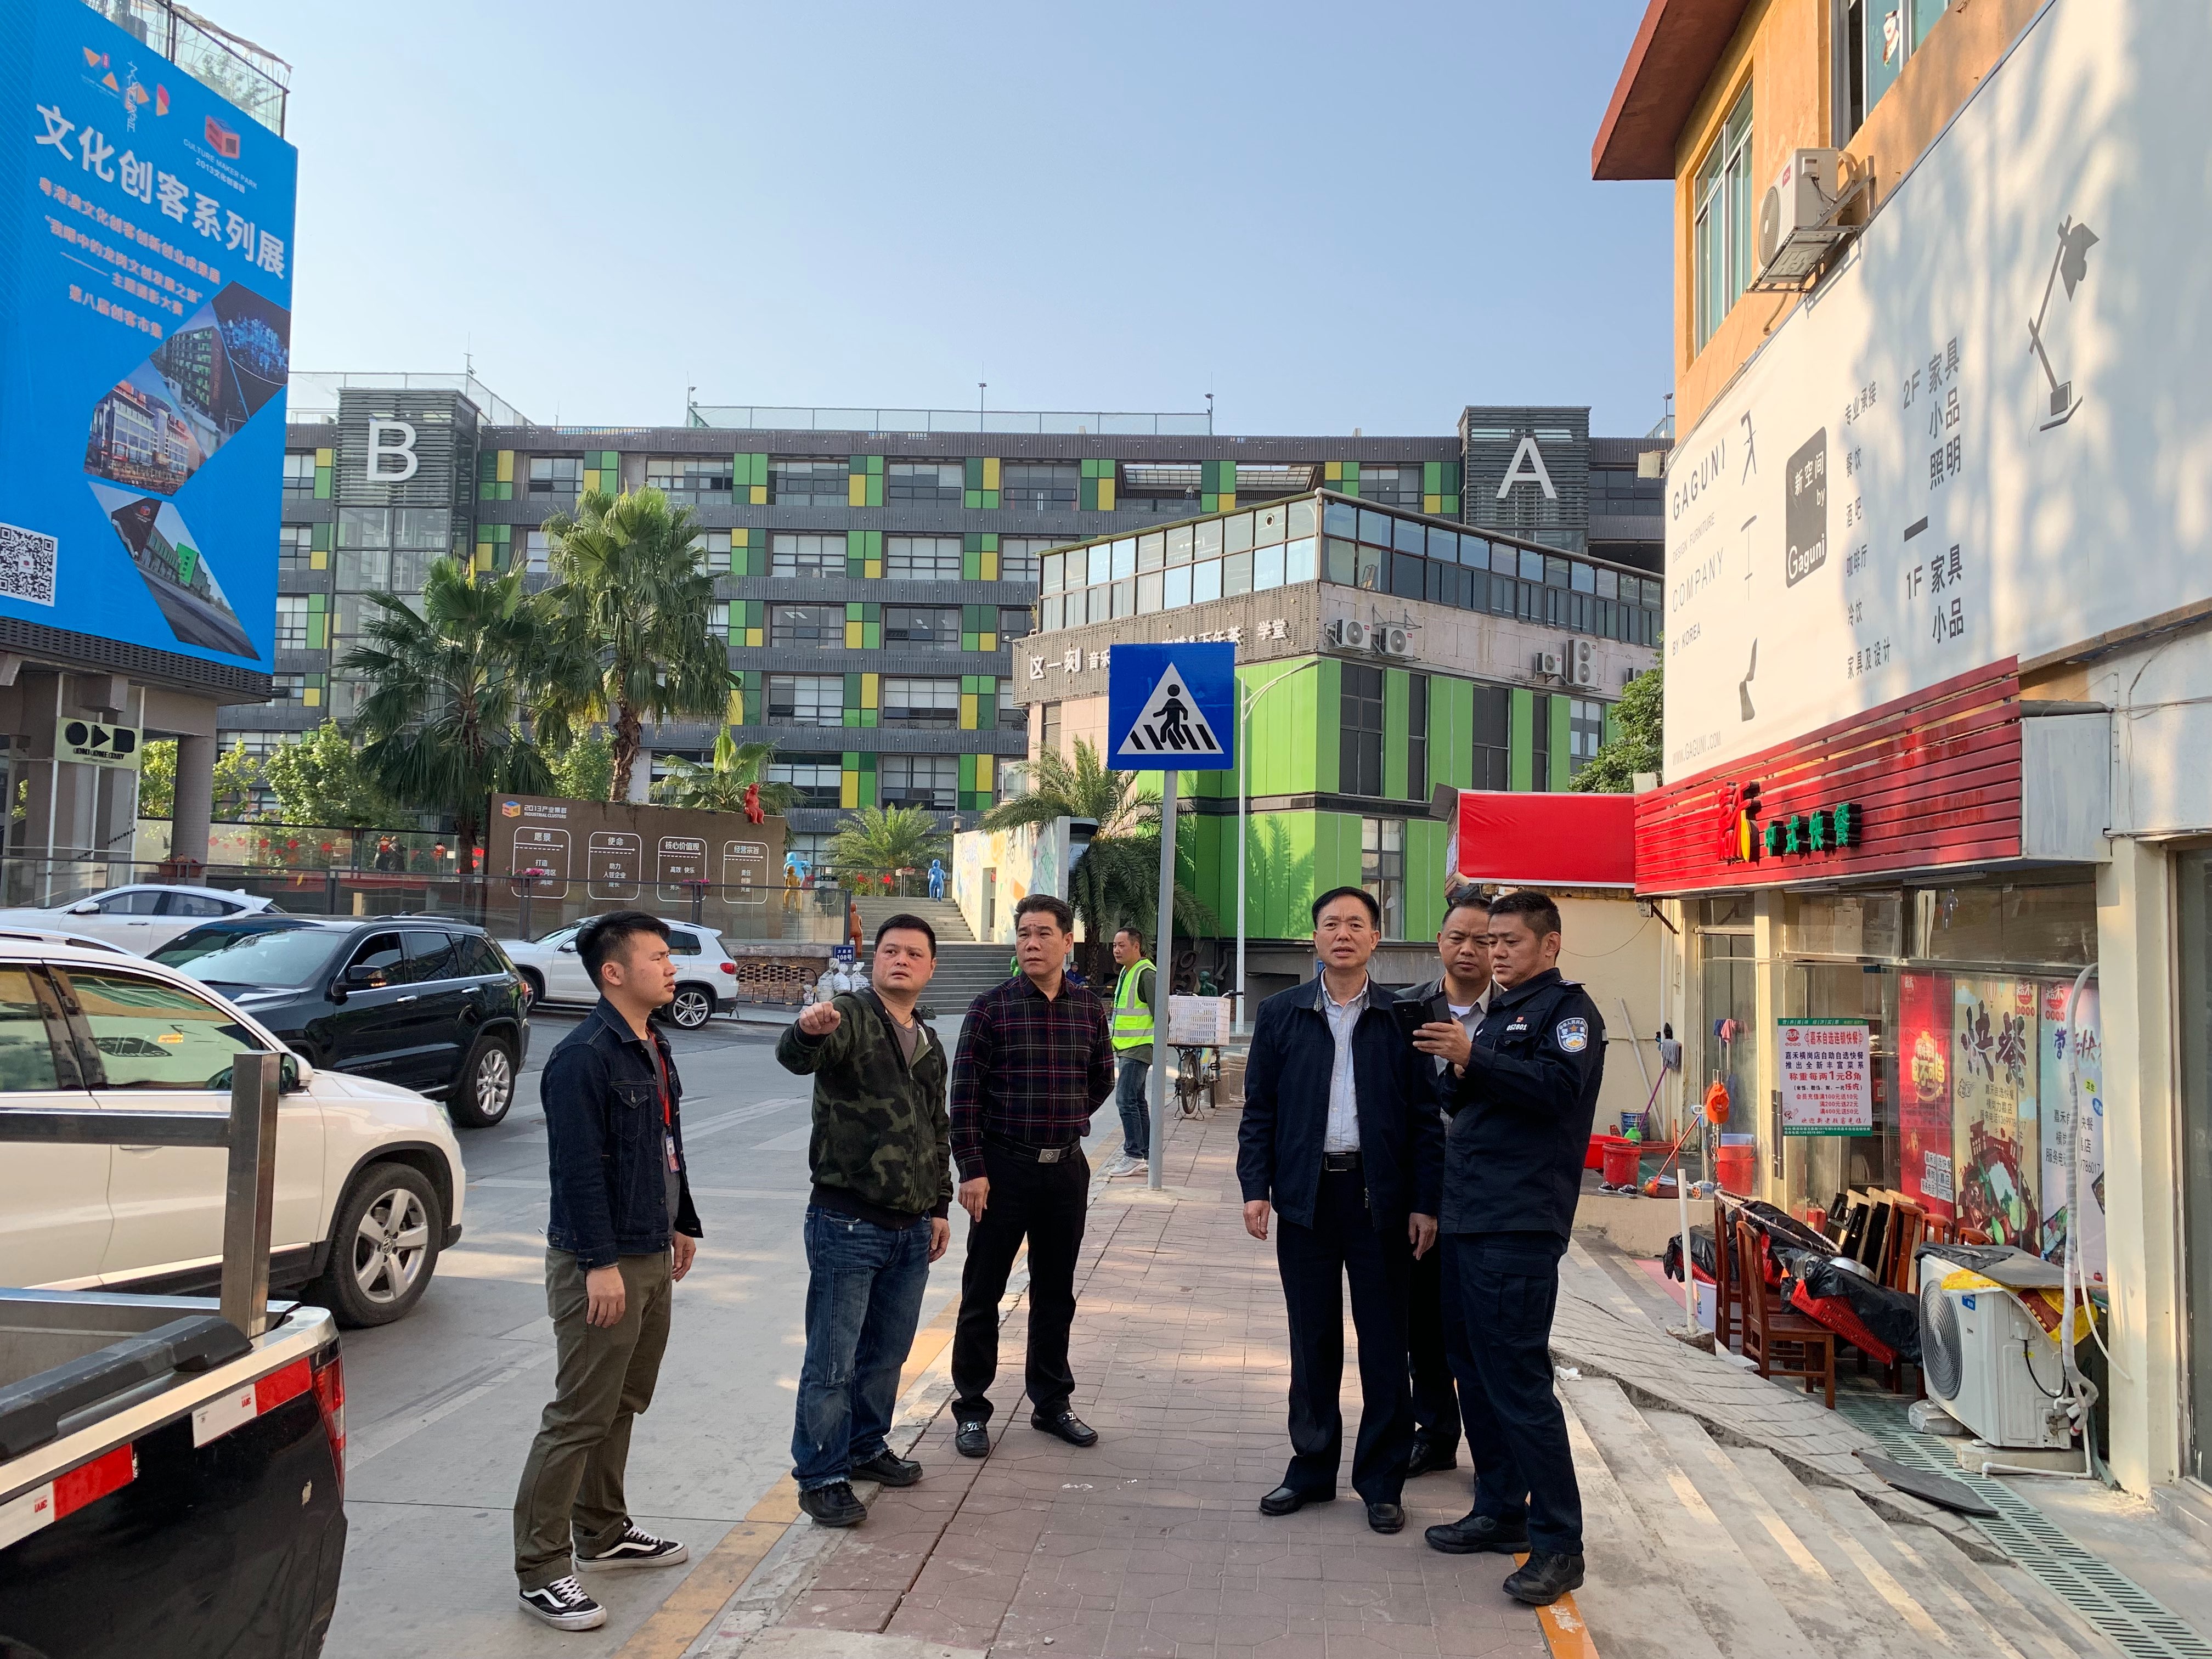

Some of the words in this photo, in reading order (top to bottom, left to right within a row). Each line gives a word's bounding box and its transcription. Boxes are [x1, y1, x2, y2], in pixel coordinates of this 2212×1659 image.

[184, 138, 215, 163] CULTURE
[216, 159, 239, 178] MAKER
[240, 174, 257, 190] PARK
[35, 104, 285, 280] 文化创客系列展
[1903, 368, 1921, 410] 2F
[1928, 336, 1959, 395] 家具
[1844, 380, 1877, 426] 专业承接
[1929, 386, 1960, 440] 小品
[366, 421, 419, 482] B
[1496, 437, 1558, 499] A
[1795, 450, 1825, 497] 新空间
[1846, 444, 1862, 478] 餐饮
[1930, 433, 1961, 492] 照明
[1673, 437, 1725, 521] GAGUNI
[1816, 487, 1826, 506] by
[1846, 496, 1862, 529] 酒吧
[1672, 540, 1688, 564] DESIGN
[1690, 511, 1715, 548] FURNITURE
[1788, 533, 1825, 580] Gaguni
[1672, 547, 1724, 613] COMPANY
[1847, 544, 1867, 578] 咖啡厅
[1906, 566, 1923, 601] 1F
[1931, 544, 1963, 595] 家具
[1847, 601, 1863, 627] 冷饮
[1932, 597, 1964, 645] 小品
[1030, 647, 1082, 680] 这一刻
[1257, 618, 1286, 641] 学堂
[1672, 638, 1680, 656] BY
[1682, 622, 1701, 649] KOREA
[1847, 636, 1891, 680] 家具及设计
[524, 804, 567, 814] 2013产业集群
[1764, 803, 1851, 856] 中式快餐
[534, 832, 551, 842] 愿景
[608, 837, 624, 847] 使命
[665, 841, 700, 851] 核心价值观
[733, 845, 760, 855] 经营宗旨
[1785, 1051, 1864, 1060] 嘉禾横岗店自助自选快餐
[1810, 1031, 1858, 1045] 嘉禾自选连锁快餐
[1961, 999, 2027, 1090] 快餐
[1785, 1061, 1864, 1070] 推出全新丰富菜系
[1789, 1070, 1861, 1081] 称重每两1元8角
[1985, 1084, 2014, 1101] 嘉禾自选快餐
[1986, 1098, 2012, 1114] 横岗力嘉店
